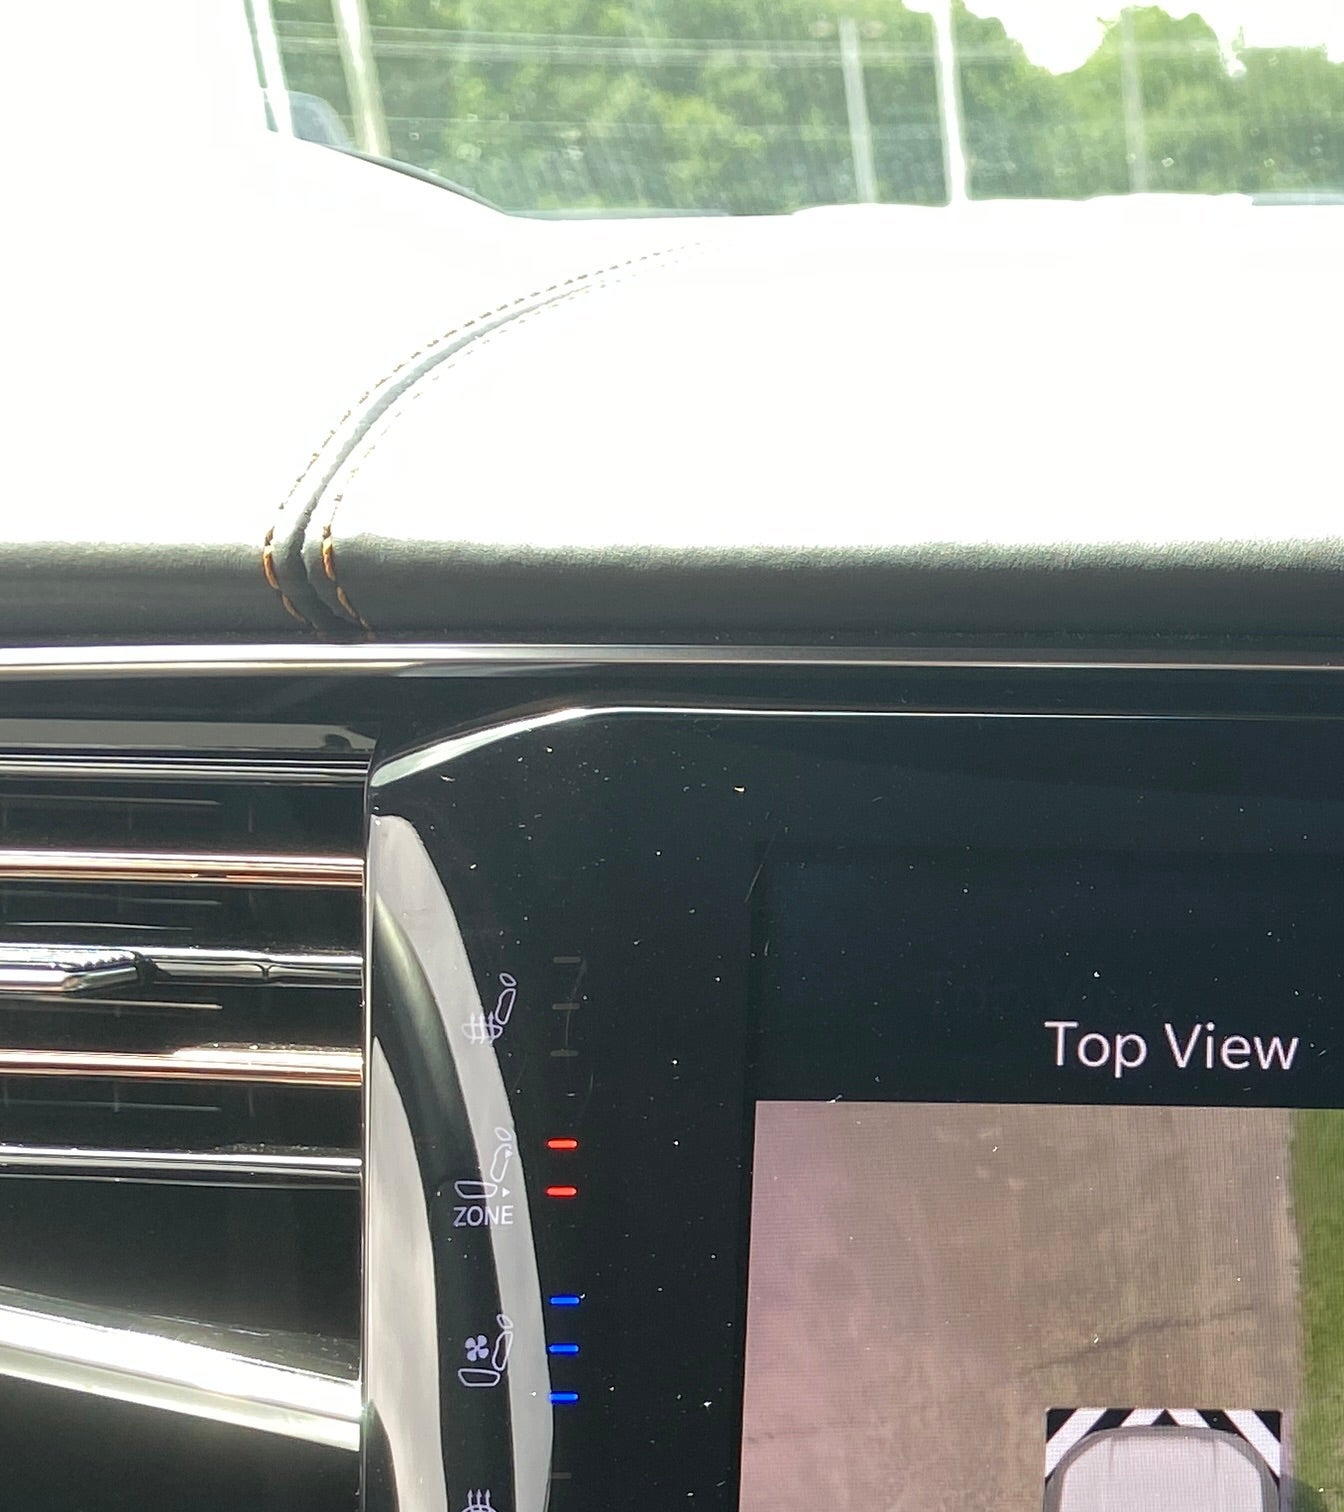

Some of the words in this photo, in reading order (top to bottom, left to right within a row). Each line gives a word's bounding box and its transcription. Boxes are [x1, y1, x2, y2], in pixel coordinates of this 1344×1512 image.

[1045, 1022, 1146, 1078] Top
[1165, 1022, 1298, 1069] View
[453, 1206, 514, 1226] ZONE
